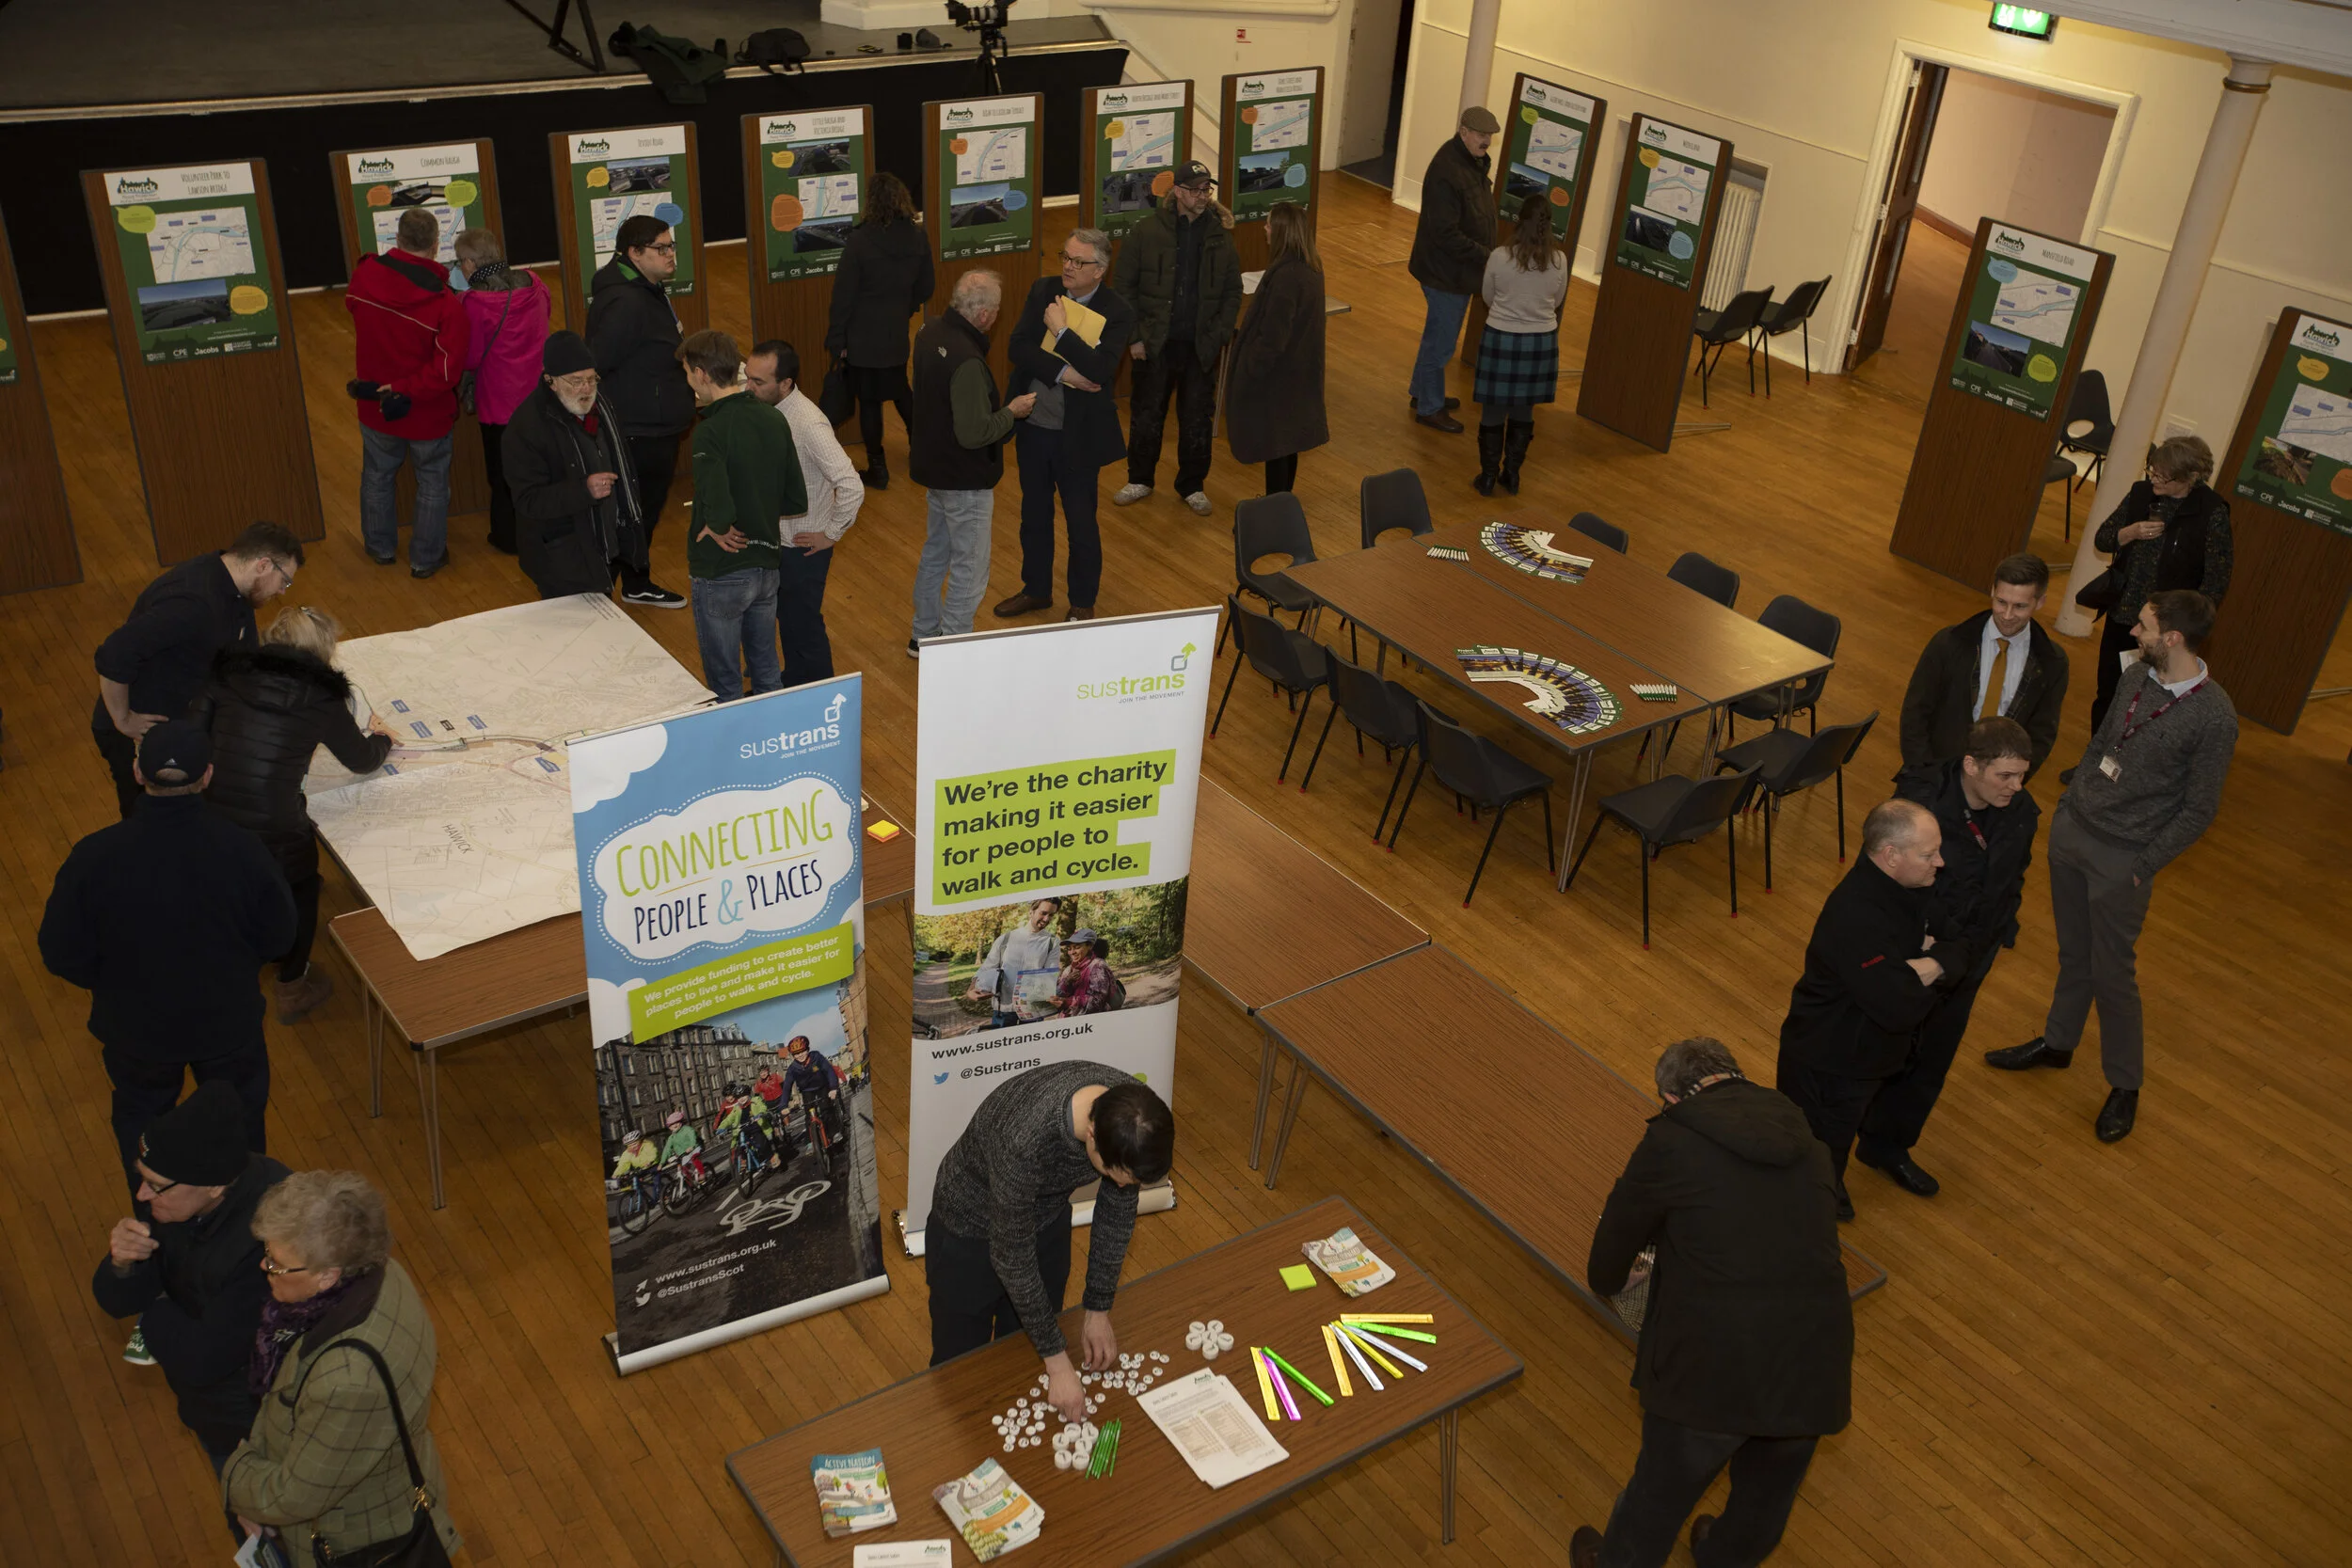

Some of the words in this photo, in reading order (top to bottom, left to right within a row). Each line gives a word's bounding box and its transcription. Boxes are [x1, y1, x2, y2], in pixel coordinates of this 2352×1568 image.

[360, 163, 392, 173] Hawick
[119, 182, 156, 194] Hawick
[805, 266, 823, 275] Jacobs
[195, 346, 219, 356] Jacobs
[2305, 329, 2338, 347] Hawick
[173, 348, 188, 356] CPE
[1970, 384, 1981, 393] CPE
[1984, 390, 2003, 402] Jacobs
[2260, 492, 2275, 502] CPE
[2278, 500, 2300, 514] Jacobs
[1076, 673, 1185, 700] sustrans
[1149, 691, 1185, 701] MOVEMENT
[739, 723, 840, 759] sustrans
[808, 739, 841, 752] MOVEMENT
[1026, 772, 1069, 793] the
[1077, 760, 1168, 786] charity
[944, 807, 1041, 836] making
[1048, 800, 1065, 820] it
[1073, 792, 1152, 818] easier
[440, 824, 474, 854] HAWICK
[616, 788, 833, 897] CONNECTING
[942, 847, 979, 867] for
[987, 830, 1074, 863] people
[1083, 827, 1109, 846] to
[942, 871, 1002, 896] walk
[1009, 860, 1057, 885] and
[1066, 852, 1138, 879] cycle.
[634, 893, 707, 944] PEOPLE
[718, 879, 744, 926] &
[746, 859, 822, 911] PLACES
[644, 990, 662, 1004] We
[665, 975, 706, 997] provide
[708, 961, 750, 980] funding
[753, 956, 765, 966] to
[768, 946, 803, 962] create
[806, 935, 838, 952] better
[646, 997, 682, 1018] places
[685, 990, 697, 1001] to
[699, 983, 718, 996] live
[721, 975, 741, 990] and
[744, 965, 775, 982] make
[778, 960, 786, 973] it
[788, 953, 823, 971] easier
[824, 947, 840, 959] for
[674, 998, 712, 1020] people
[714, 991, 726, 1003] to
[729, 983, 755, 998] walk
[757, 976, 779, 990] and
[781, 969, 815, 985] cycle.
[931, 1022, 1093, 1059] www.sustrans.org.uk
[961, 1057, 1041, 1080] @Sustrans
[655, 1238, 777, 1284] www.sustrans.org.uk
[657, 1262, 745, 1299] @SustransScot
[848, 1455, 875, 1468] NATION
